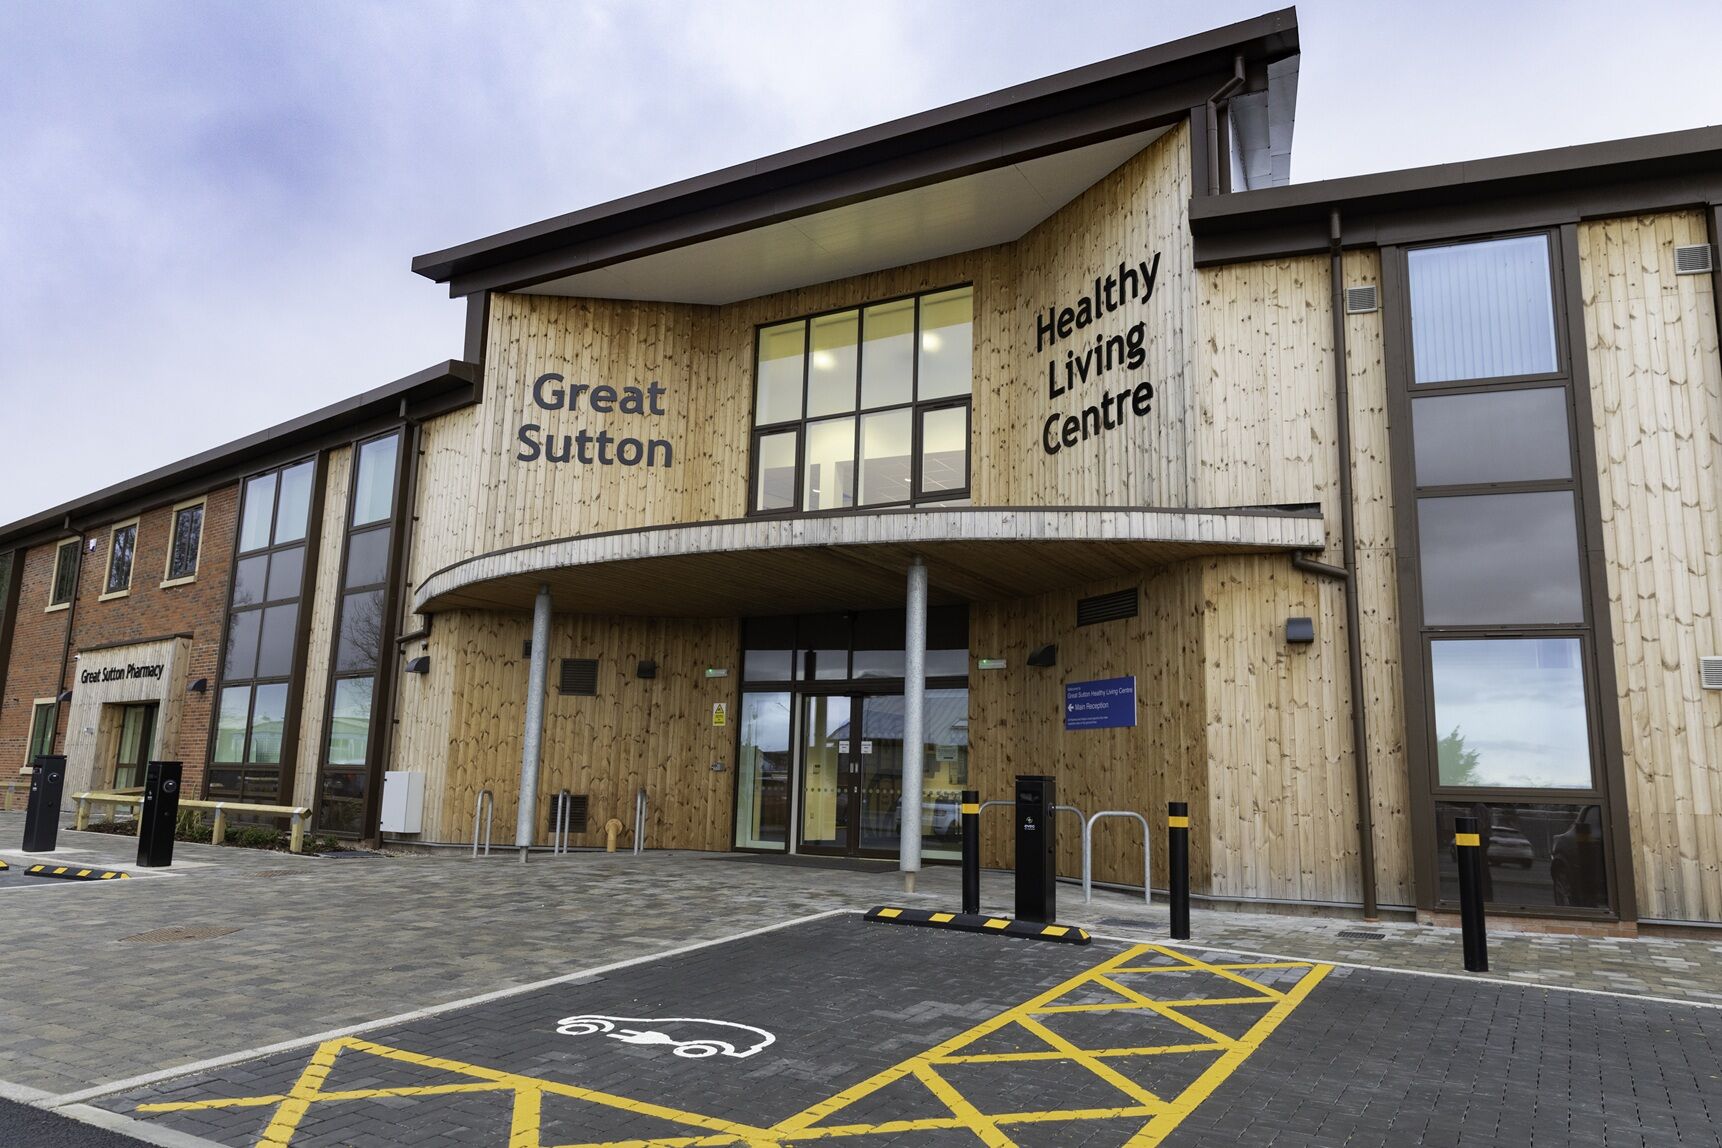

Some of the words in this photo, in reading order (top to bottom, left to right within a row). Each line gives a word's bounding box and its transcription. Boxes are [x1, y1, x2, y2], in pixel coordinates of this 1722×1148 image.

[1036, 252, 1161, 353] Healthy
[1048, 321, 1146, 400] Living
[533, 373, 666, 416] Great
[1042, 381, 1154, 455] Centre
[517, 423, 673, 468] Sutton
[81, 669, 101, 684] Great
[102, 667, 125, 682] Sutton
[126, 663, 164, 680] Pharmacy
